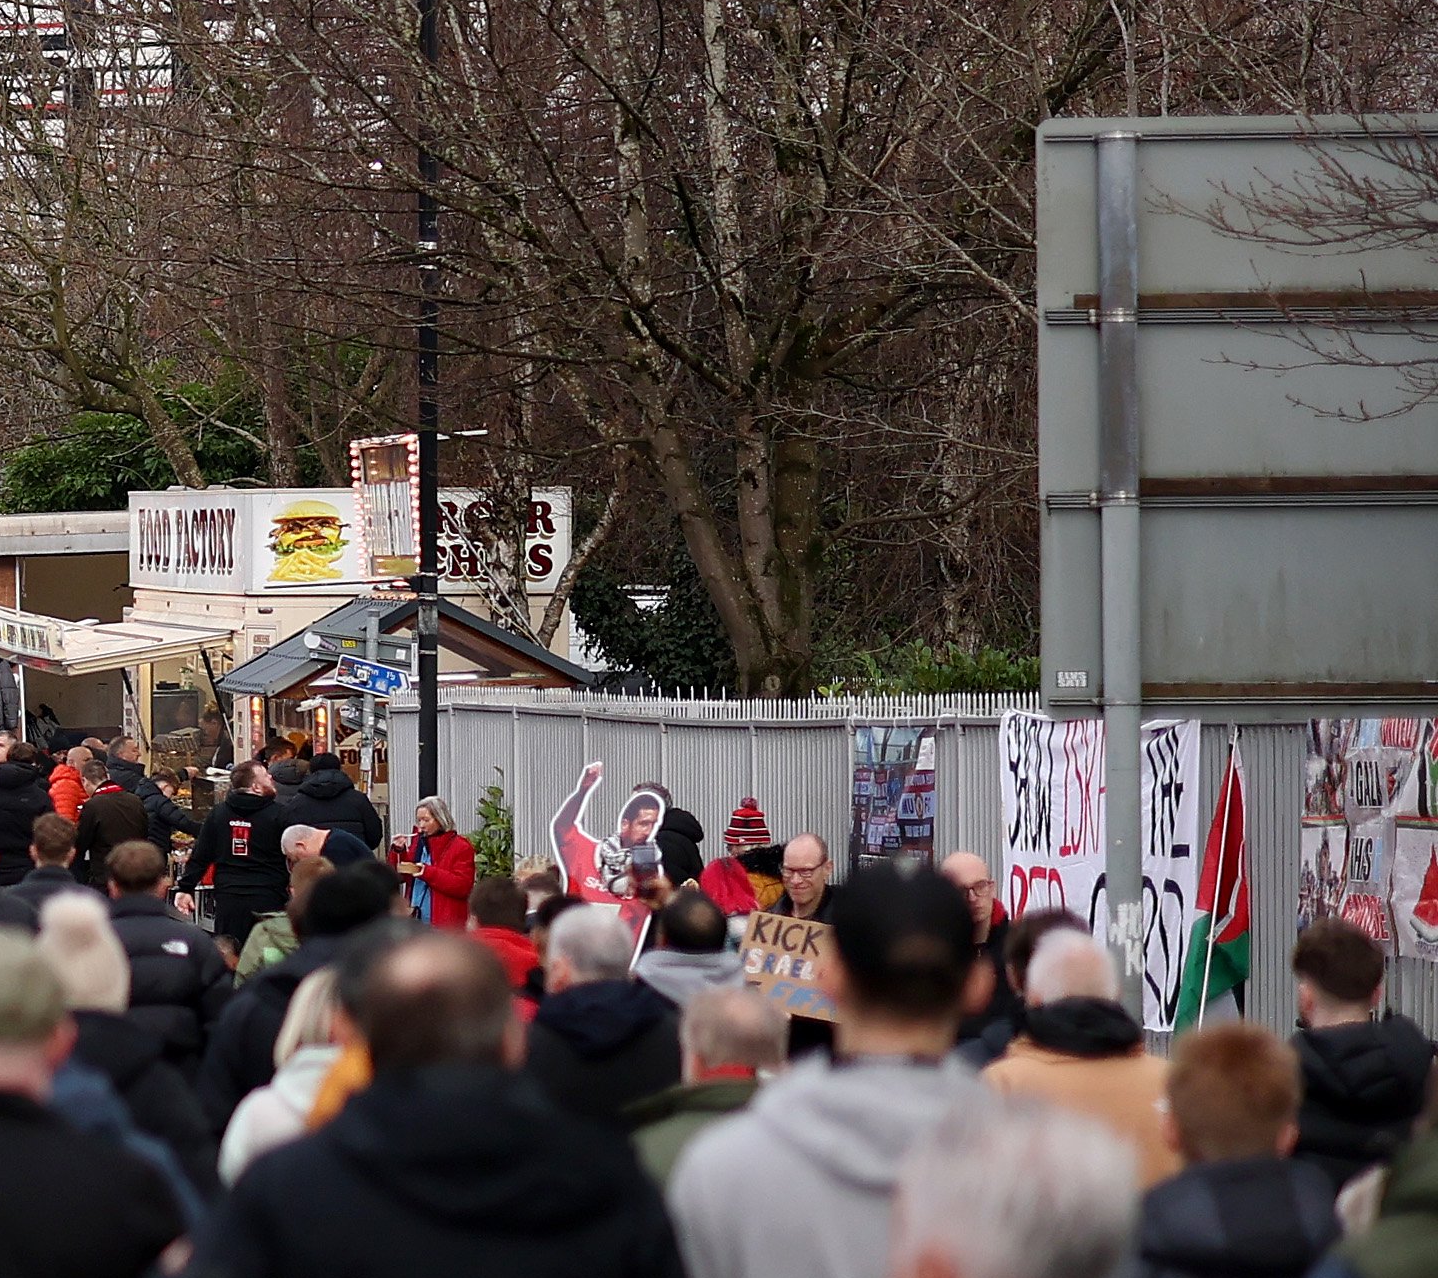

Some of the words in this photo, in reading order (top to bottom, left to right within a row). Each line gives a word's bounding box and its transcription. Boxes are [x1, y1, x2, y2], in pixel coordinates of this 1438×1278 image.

[139, 508, 171, 572] FOOD
[176, 508, 236, 574] FACTORY
[751, 915, 824, 957] KICK
